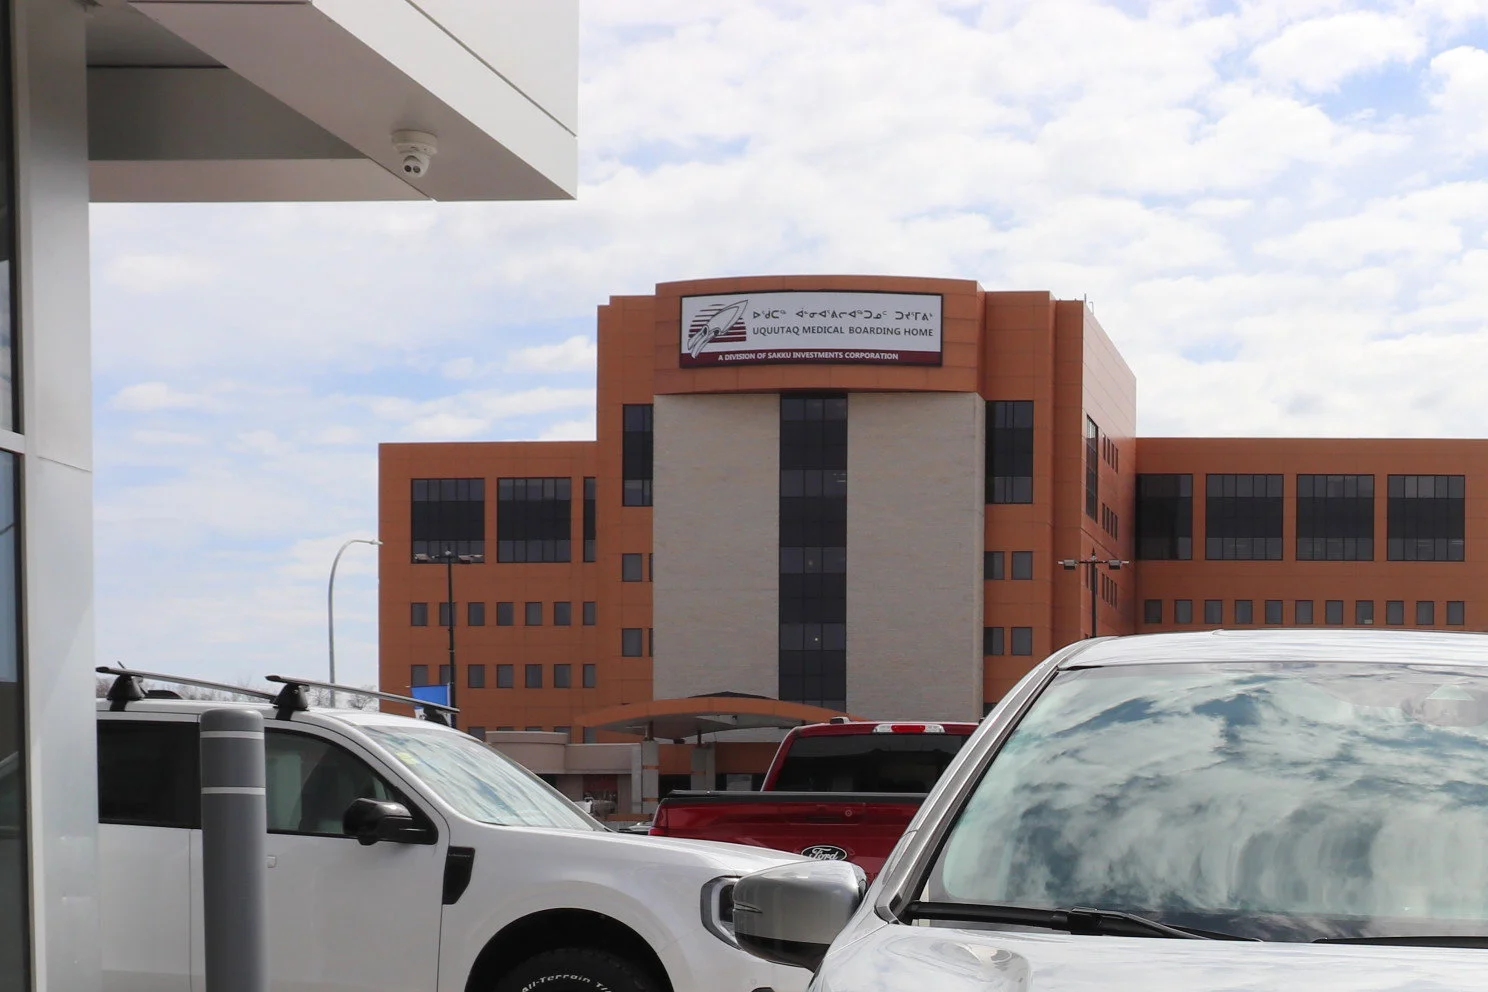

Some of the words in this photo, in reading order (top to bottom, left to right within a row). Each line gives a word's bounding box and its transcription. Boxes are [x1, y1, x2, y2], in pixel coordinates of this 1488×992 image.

[752, 326, 800, 336] UQUUTAQ
[802, 326, 845, 334] MEDICAL
[848, 326, 901, 336] BOARDING
[904, 328, 934, 337] HOME
[724, 353, 756, 361] DIVISION
[757, 352, 766, 360] OF
[792, 351, 843, 359] INVESTMENTS
[845, 351, 899, 361] CORPORATION
[809, 847, 839, 861] Ford
